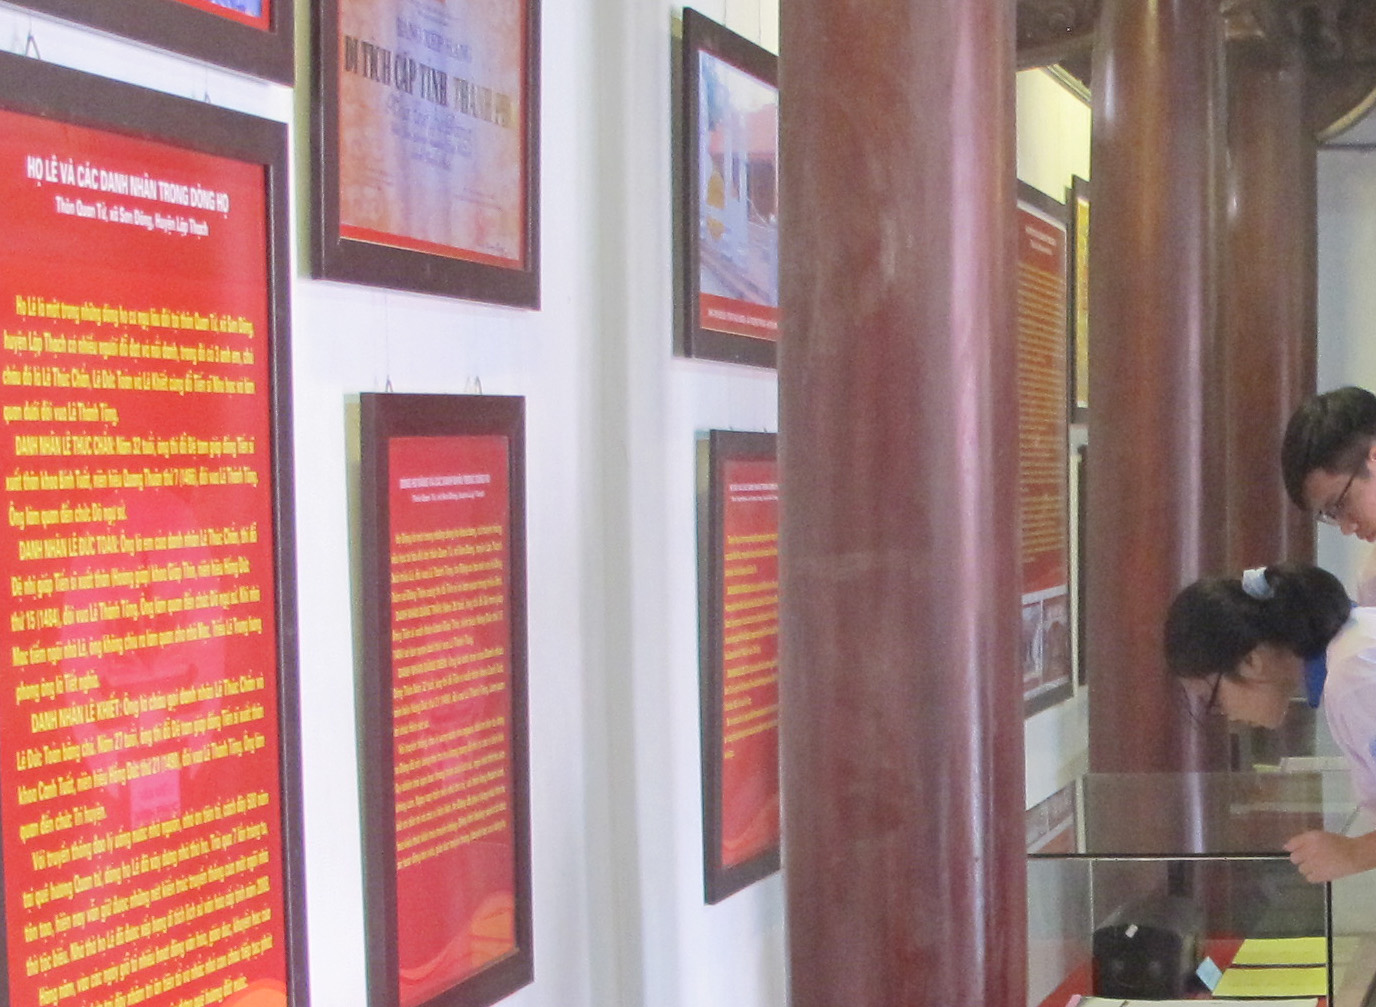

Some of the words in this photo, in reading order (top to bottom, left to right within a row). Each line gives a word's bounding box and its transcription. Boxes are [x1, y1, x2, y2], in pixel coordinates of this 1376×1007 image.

[27, 155, 43, 187] HỌ
[45, 154, 58, 182] LÊ
[60, 158, 76, 186] VÀ
[77, 161, 99, 190] CÁC
[100, 170, 128, 194] DANH
[129, 172, 157, 200] NHÂN
[158, 181, 189, 206] TRONG
[190, 183, 215, 210] DÒNG
[216, 191, 230, 219] HỌ
